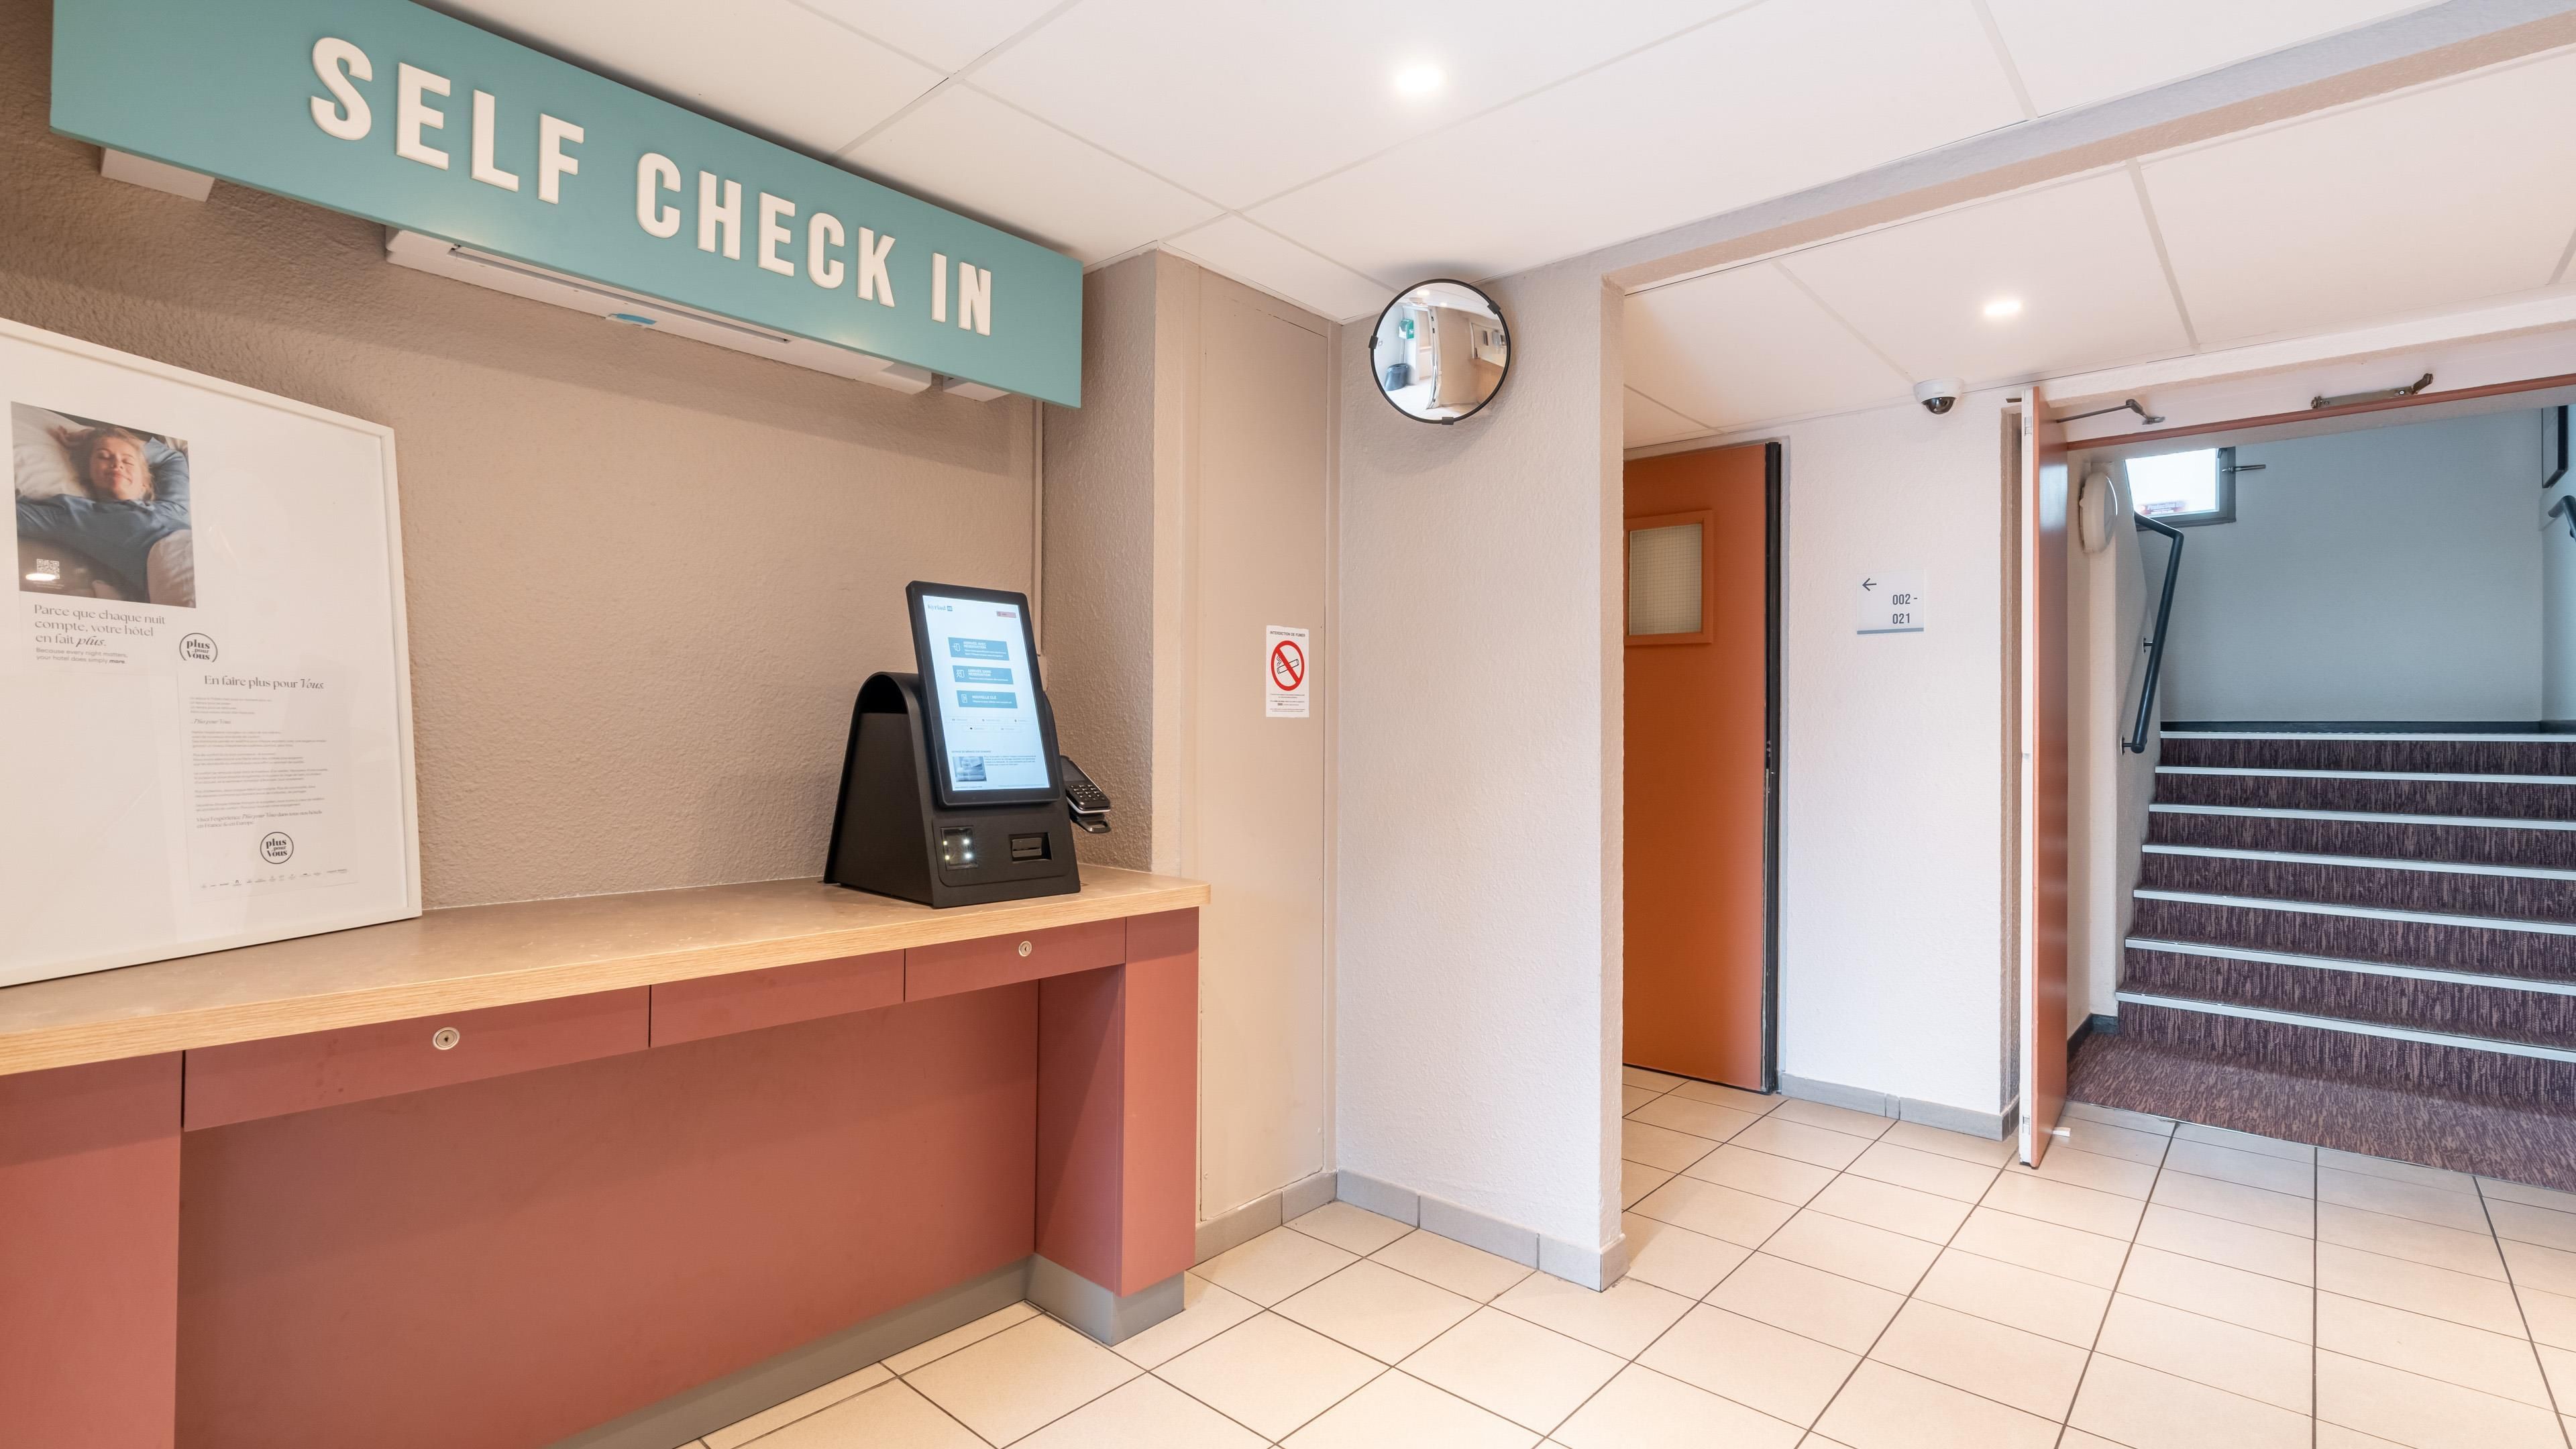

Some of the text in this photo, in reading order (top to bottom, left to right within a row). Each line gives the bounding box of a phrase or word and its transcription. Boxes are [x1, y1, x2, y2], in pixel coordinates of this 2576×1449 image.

[310, 36, 991, 335] SELF CHECK IN
[1892, 594, 1911, 605] 002
[34, 604, 165, 625] Parce que chaque nuit
[1892, 613, 1910, 624] 021
[91, 625, 122, 634] votre
[125, 625, 154, 636] hôtel
[36, 635, 52, 643] en
[55, 633, 74, 644] fait
[186, 639, 210, 649] plus
[205, 675, 324, 690] En faire plus pour Vous
[266, 838, 287, 849] plus
